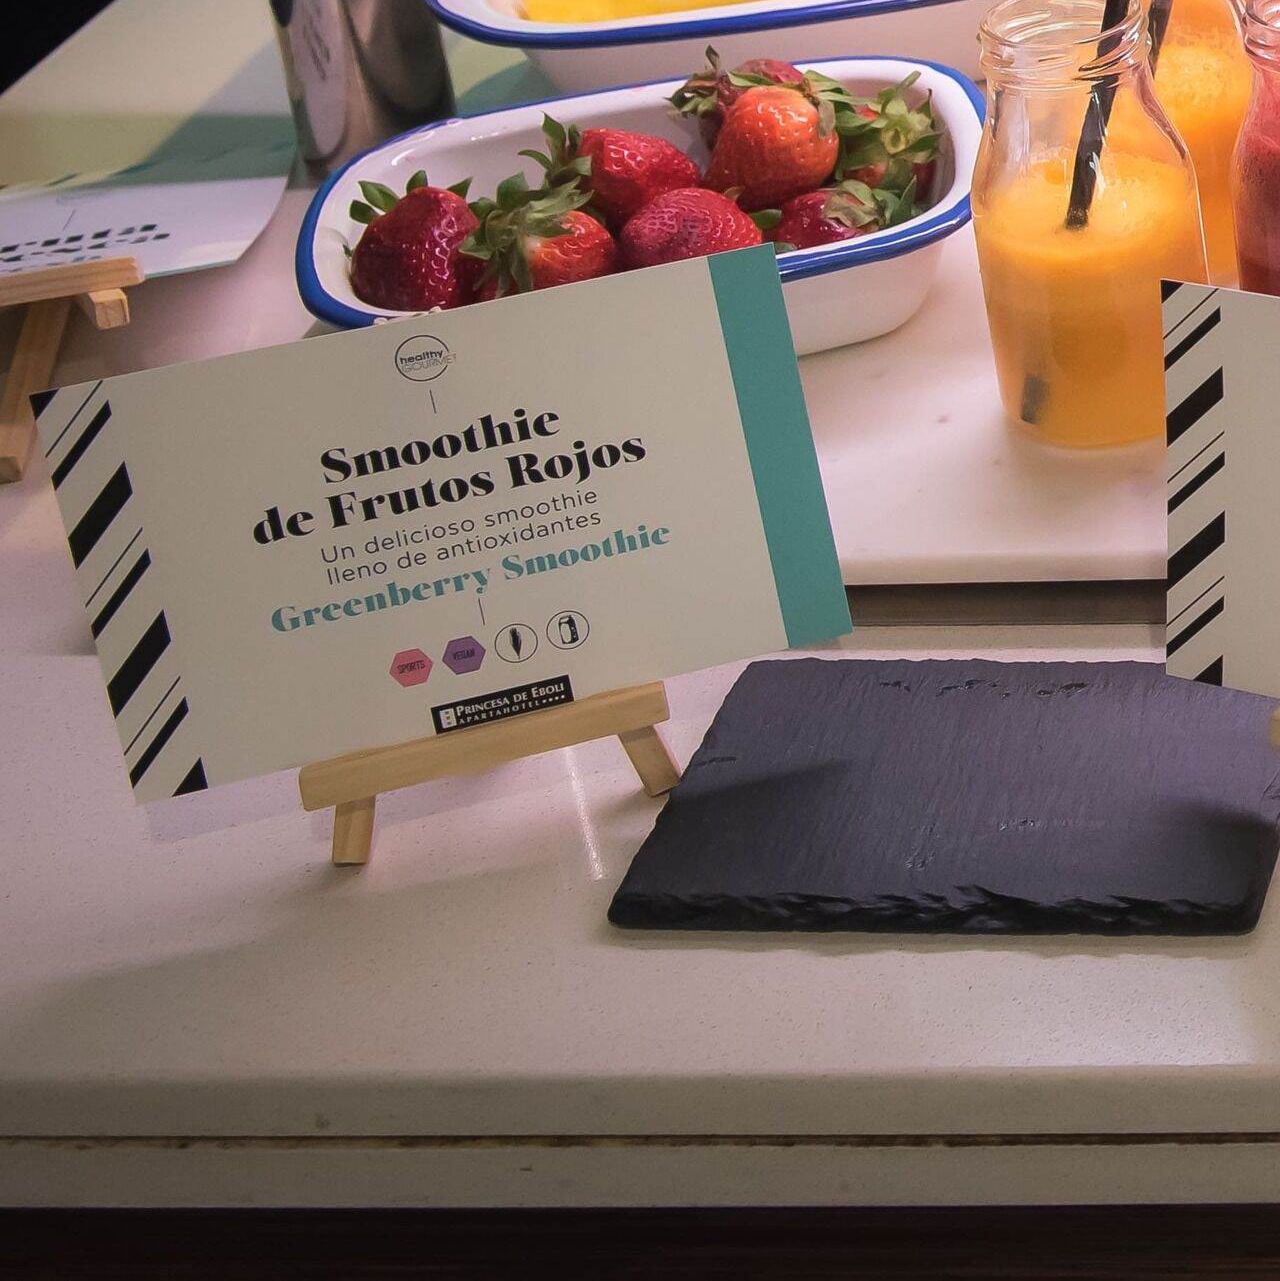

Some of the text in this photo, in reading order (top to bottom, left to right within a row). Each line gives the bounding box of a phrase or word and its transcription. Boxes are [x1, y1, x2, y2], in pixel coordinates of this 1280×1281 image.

[399, 350, 444, 364] healthy
[402, 352, 457, 373] GOURMET
[321, 408, 561, 484] Smoothie
[253, 437, 647, 545] de Frutos Rojos
[321, 489, 598, 564] Un delicioso smoothie
[326, 511, 602, 585] lleno de antioxidantes
[271, 524, 671, 632] Greenberry Smoothie
[397, 659, 426, 674] SPORTS
[452, 648, 476, 662] VEGAN
[455, 682, 565, 717] PRINCESA DE EBOLI
[458, 700, 541, 726] APARTAHOTEL
